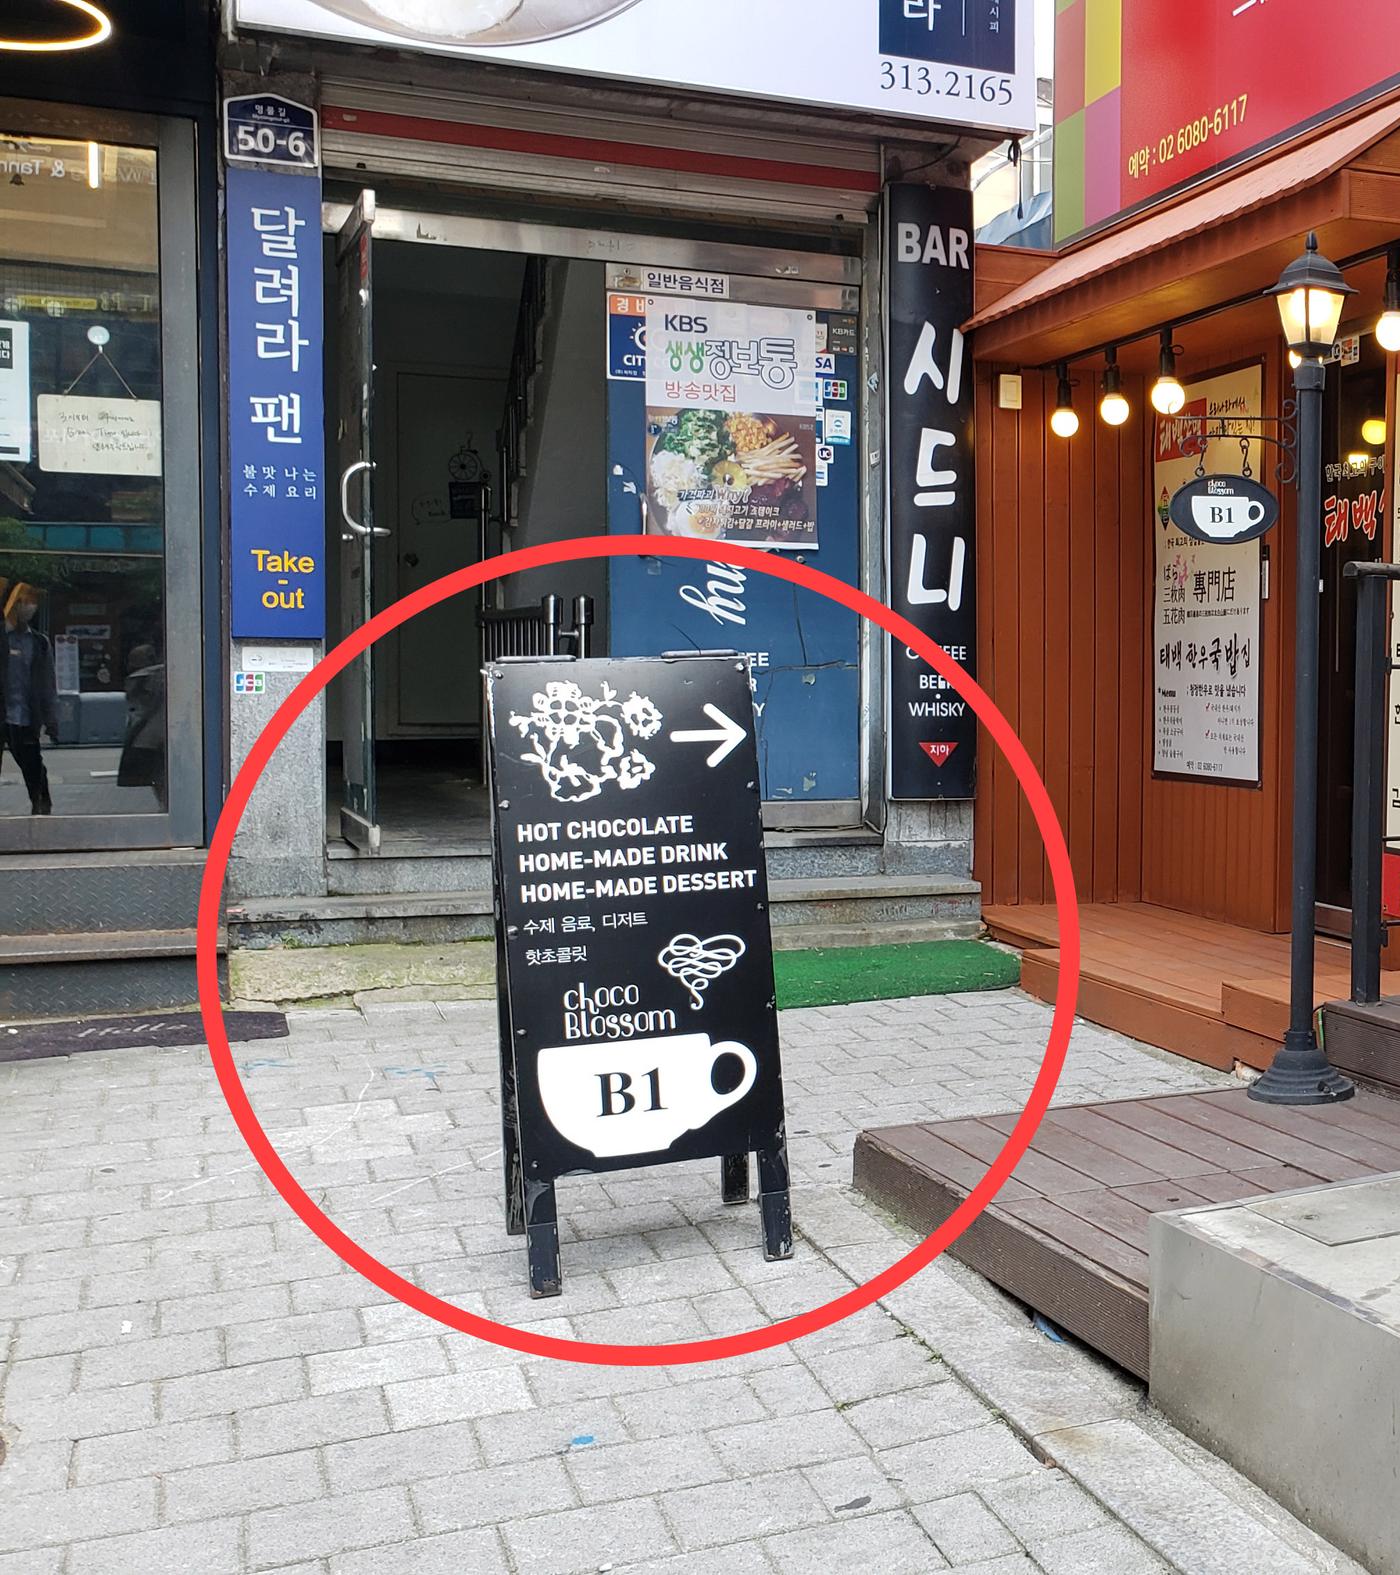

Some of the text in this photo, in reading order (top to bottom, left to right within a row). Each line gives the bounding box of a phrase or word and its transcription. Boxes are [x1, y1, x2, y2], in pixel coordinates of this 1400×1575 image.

[880, 61, 1012, 106] 313.2165
[237, 125, 306, 156] 50-6
[1128, 145, 1150, 179] 예약
[1159, 134, 1174, 164] 02
[1177, 93, 1248, 154] 6080-6117
[897, 221, 970, 270] BAR
[647, 272, 725, 294] 일반음식점
[250, 206, 309, 444] 달려라 팬
[664, 314, 708, 334] KBS
[665, 336, 798, 391] 생생정보통
[665, 381, 737, 403] 방송맛집
[243, 464, 317, 482] 불맛 나는
[904, 320, 966, 612] 시드니
[243, 483, 317, 500] 수제 요리
[1210, 506, 1235, 524] B1
[1324, 489, 1384, 548] 태백
[250, 549, 315, 573] Take
[261, 587, 305, 609] out
[1160, 640, 1182, 671] 태백
[908, 702, 966, 717] WHISKY
[517, 815, 694, 843] HOT CHOCOLATE
[519, 842, 728, 873] HOME-MADE DRINK
[520, 869, 757, 904] HOME-MADE DESSERT
[523, 917, 555, 936] 수제
[602, 911, 649, 929] 디저트
[525, 945, 588, 967] 핫초콜릿
[563, 982, 640, 1015] choco
[565, 1008, 676, 1040] Blossom
[594, 1067, 669, 1117] B1
